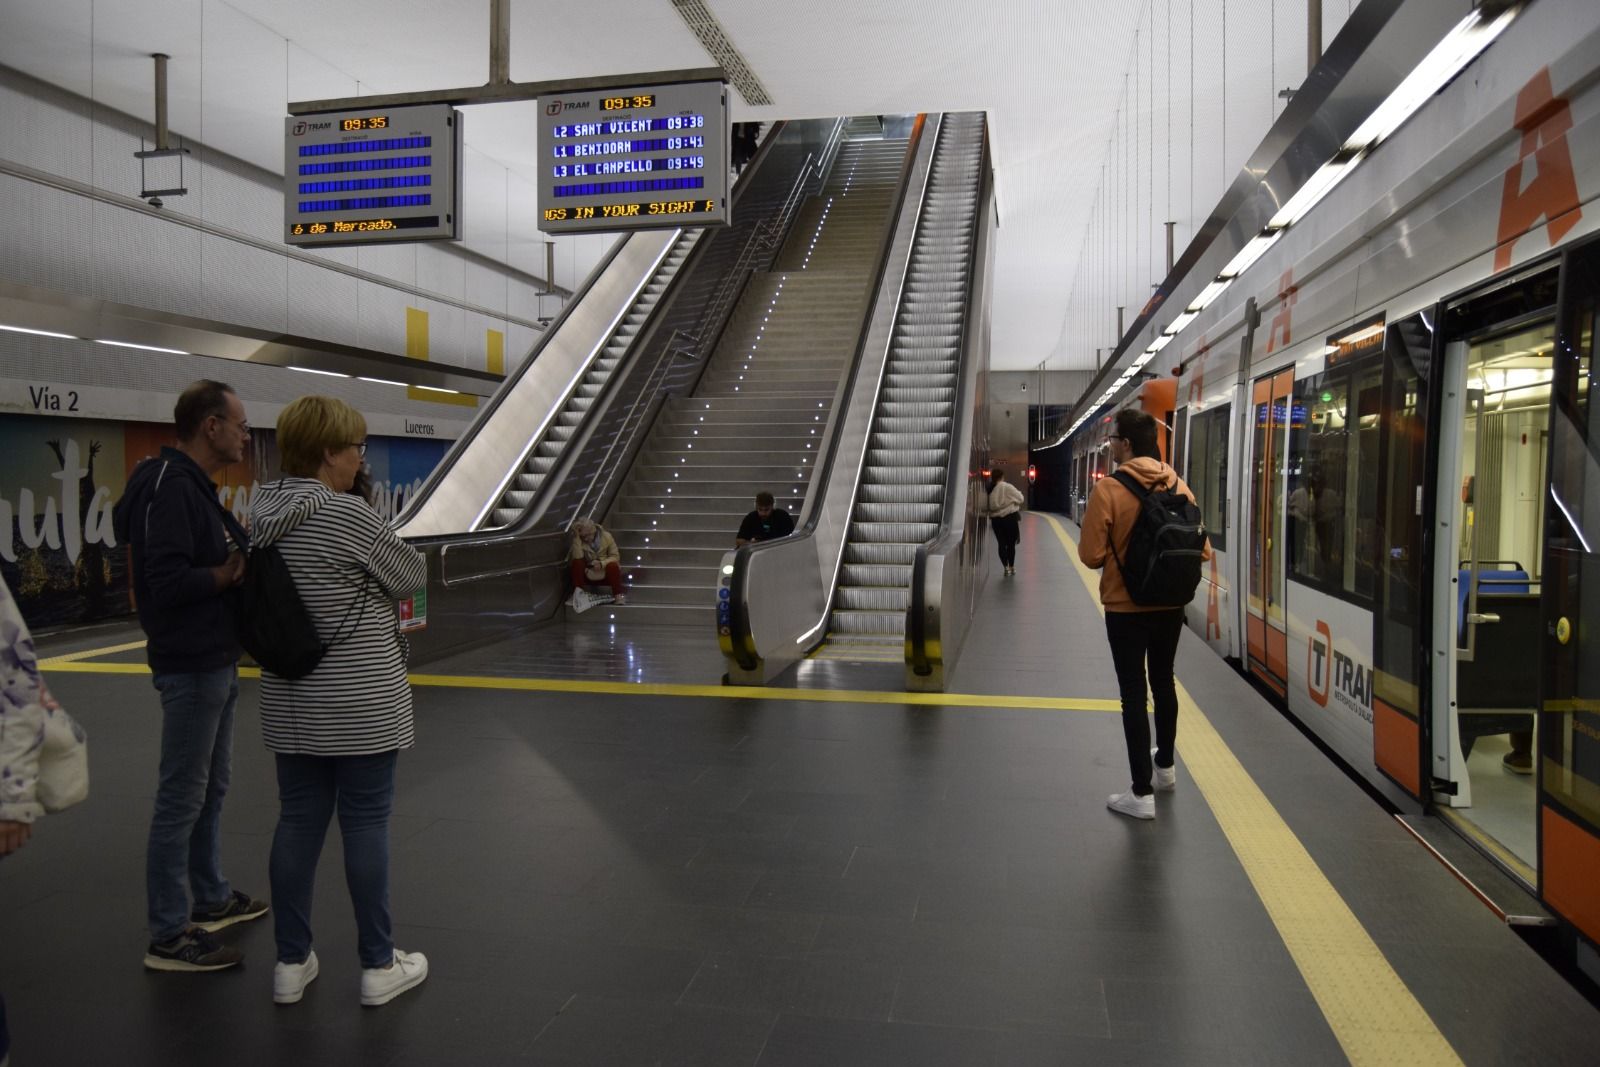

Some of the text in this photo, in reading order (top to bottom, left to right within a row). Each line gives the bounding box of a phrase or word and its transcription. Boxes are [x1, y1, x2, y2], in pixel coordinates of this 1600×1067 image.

[563, 101, 590, 110] TRAM
[605, 96, 652, 110] 09:35
[308, 122, 331, 131] TRAM
[344, 117, 386, 131] 09:35
[553, 116, 704, 138] L2 SANT VICENT 09:38
[553, 136, 704, 158] L1 BENIDORM 09:41
[553, 156, 704, 178] L3 EL CAMPELLO 09:49
[574, 207, 594, 219] IN
[603, 204, 640, 217] YOUR
[649, 201, 696, 215] SIGHT
[310, 223, 327, 235] de
[334, 219, 398, 233] Mercado.
[29, 385, 79, 411] Vía 2
[405, 419, 434, 435] Luceros
